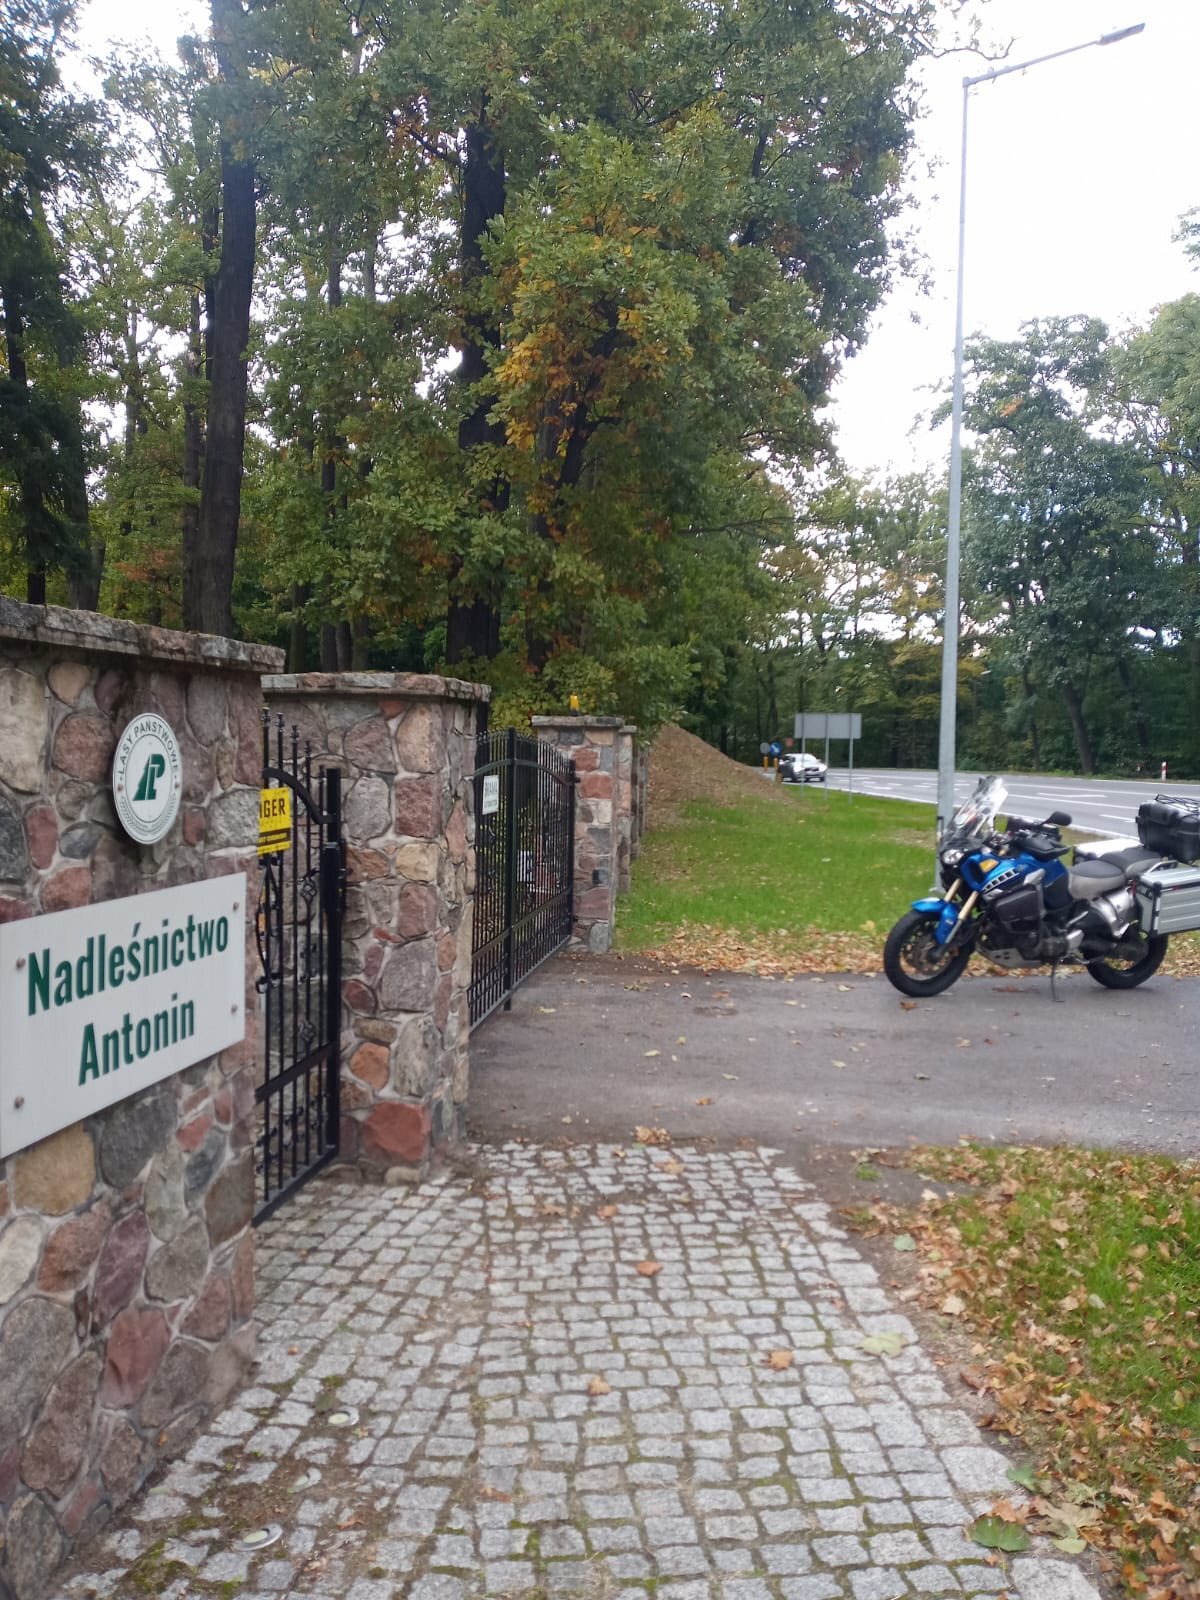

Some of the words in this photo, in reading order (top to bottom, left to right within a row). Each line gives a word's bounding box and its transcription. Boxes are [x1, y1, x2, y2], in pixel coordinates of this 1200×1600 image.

[118, 735, 133, 775] LASY
[28, 914, 229, 1016] Nadleśnictwo
[78, 993, 195, 1087] Antonin
